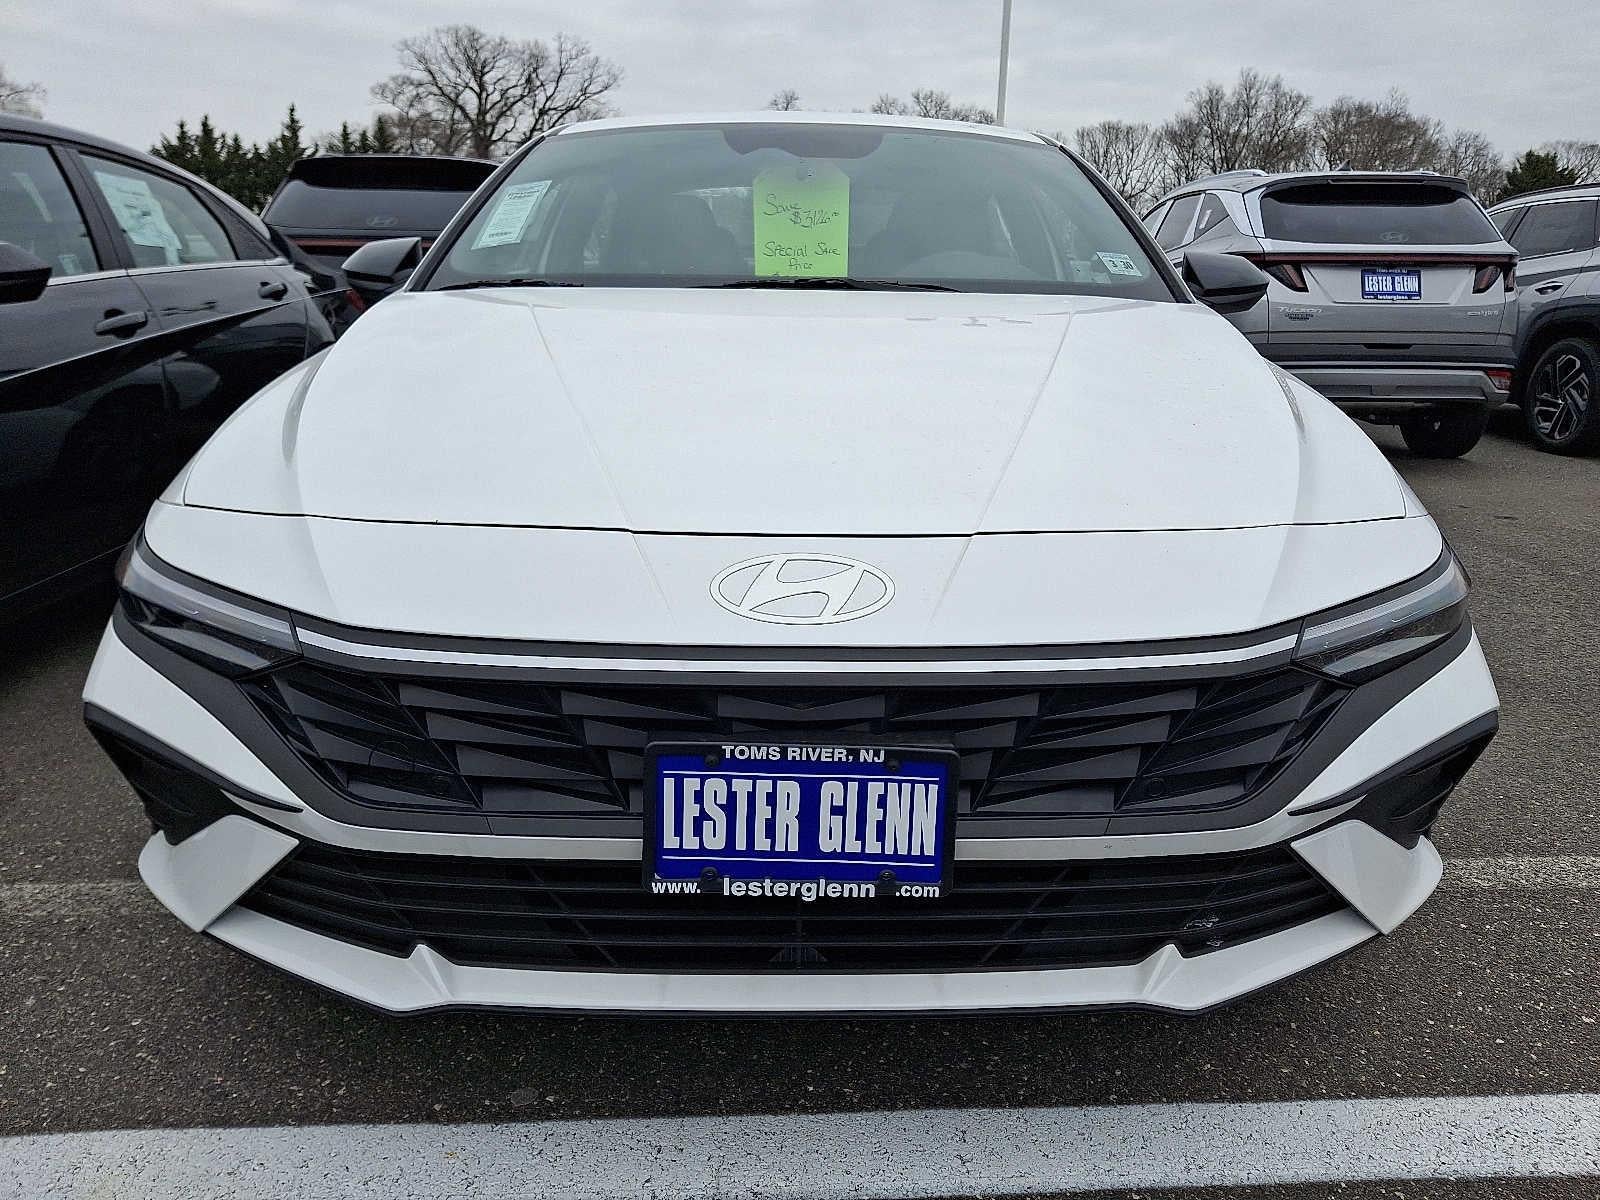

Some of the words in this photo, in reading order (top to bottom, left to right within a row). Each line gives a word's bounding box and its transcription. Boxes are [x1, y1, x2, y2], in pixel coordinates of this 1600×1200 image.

[1365, 275, 1393, 292] LESTER
[1395, 275, 1419, 292] GLENN
[722, 745, 781, 760] TOMS
[787, 747, 853, 762] RIVER,
[859, 749, 885, 763] NJ
[663, 777, 800, 852] LESTER
[818, 780, 938, 856] GLENN
[651, 881, 701, 894] www.
[723, 878, 875, 901] lesterglenn
[895, 883, 940, 898] .com
